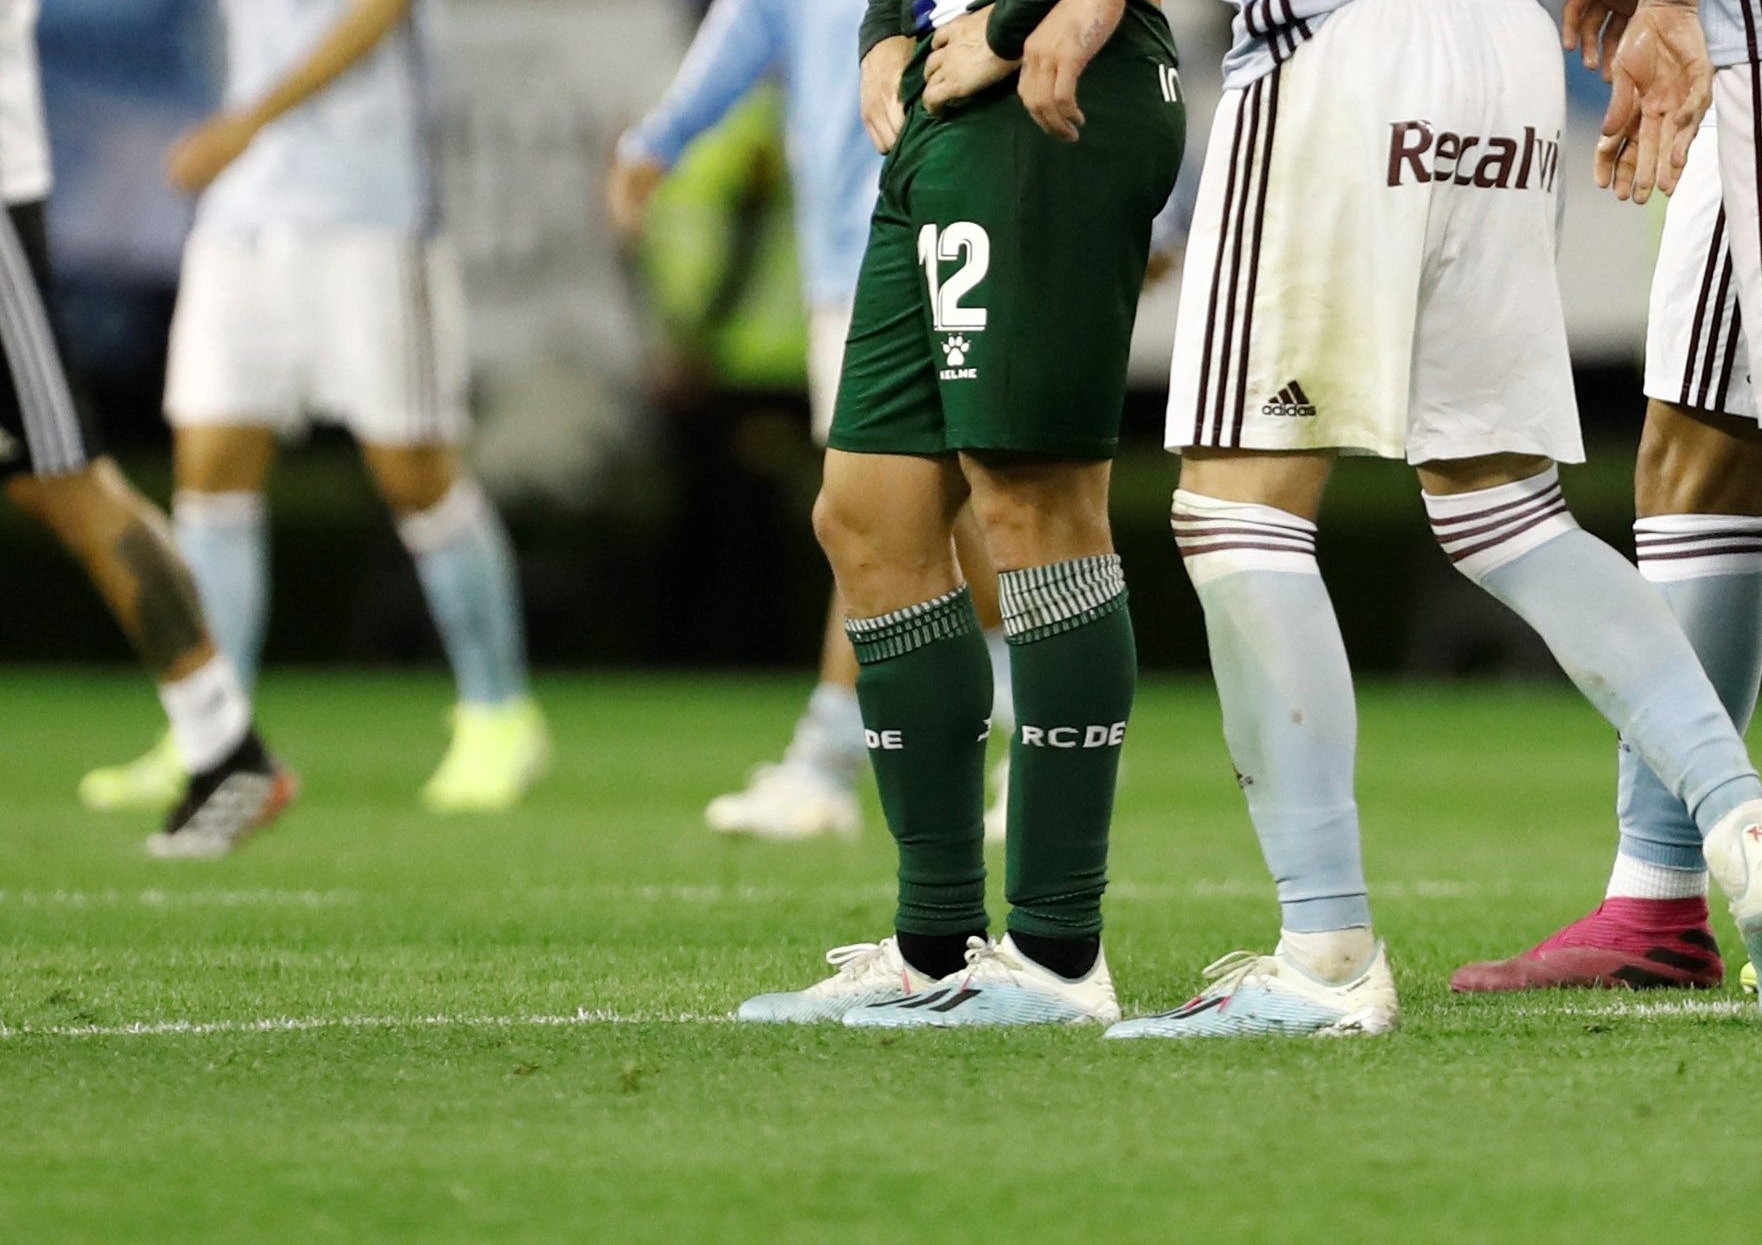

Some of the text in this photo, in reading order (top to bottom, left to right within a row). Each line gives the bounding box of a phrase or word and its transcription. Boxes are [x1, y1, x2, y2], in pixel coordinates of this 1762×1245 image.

[1387, 119, 1561, 193] Recalvi
[917, 221, 991, 331] 12
[1261, 405, 1316, 416] adidas
[1021, 721, 1127, 748] RCDE
